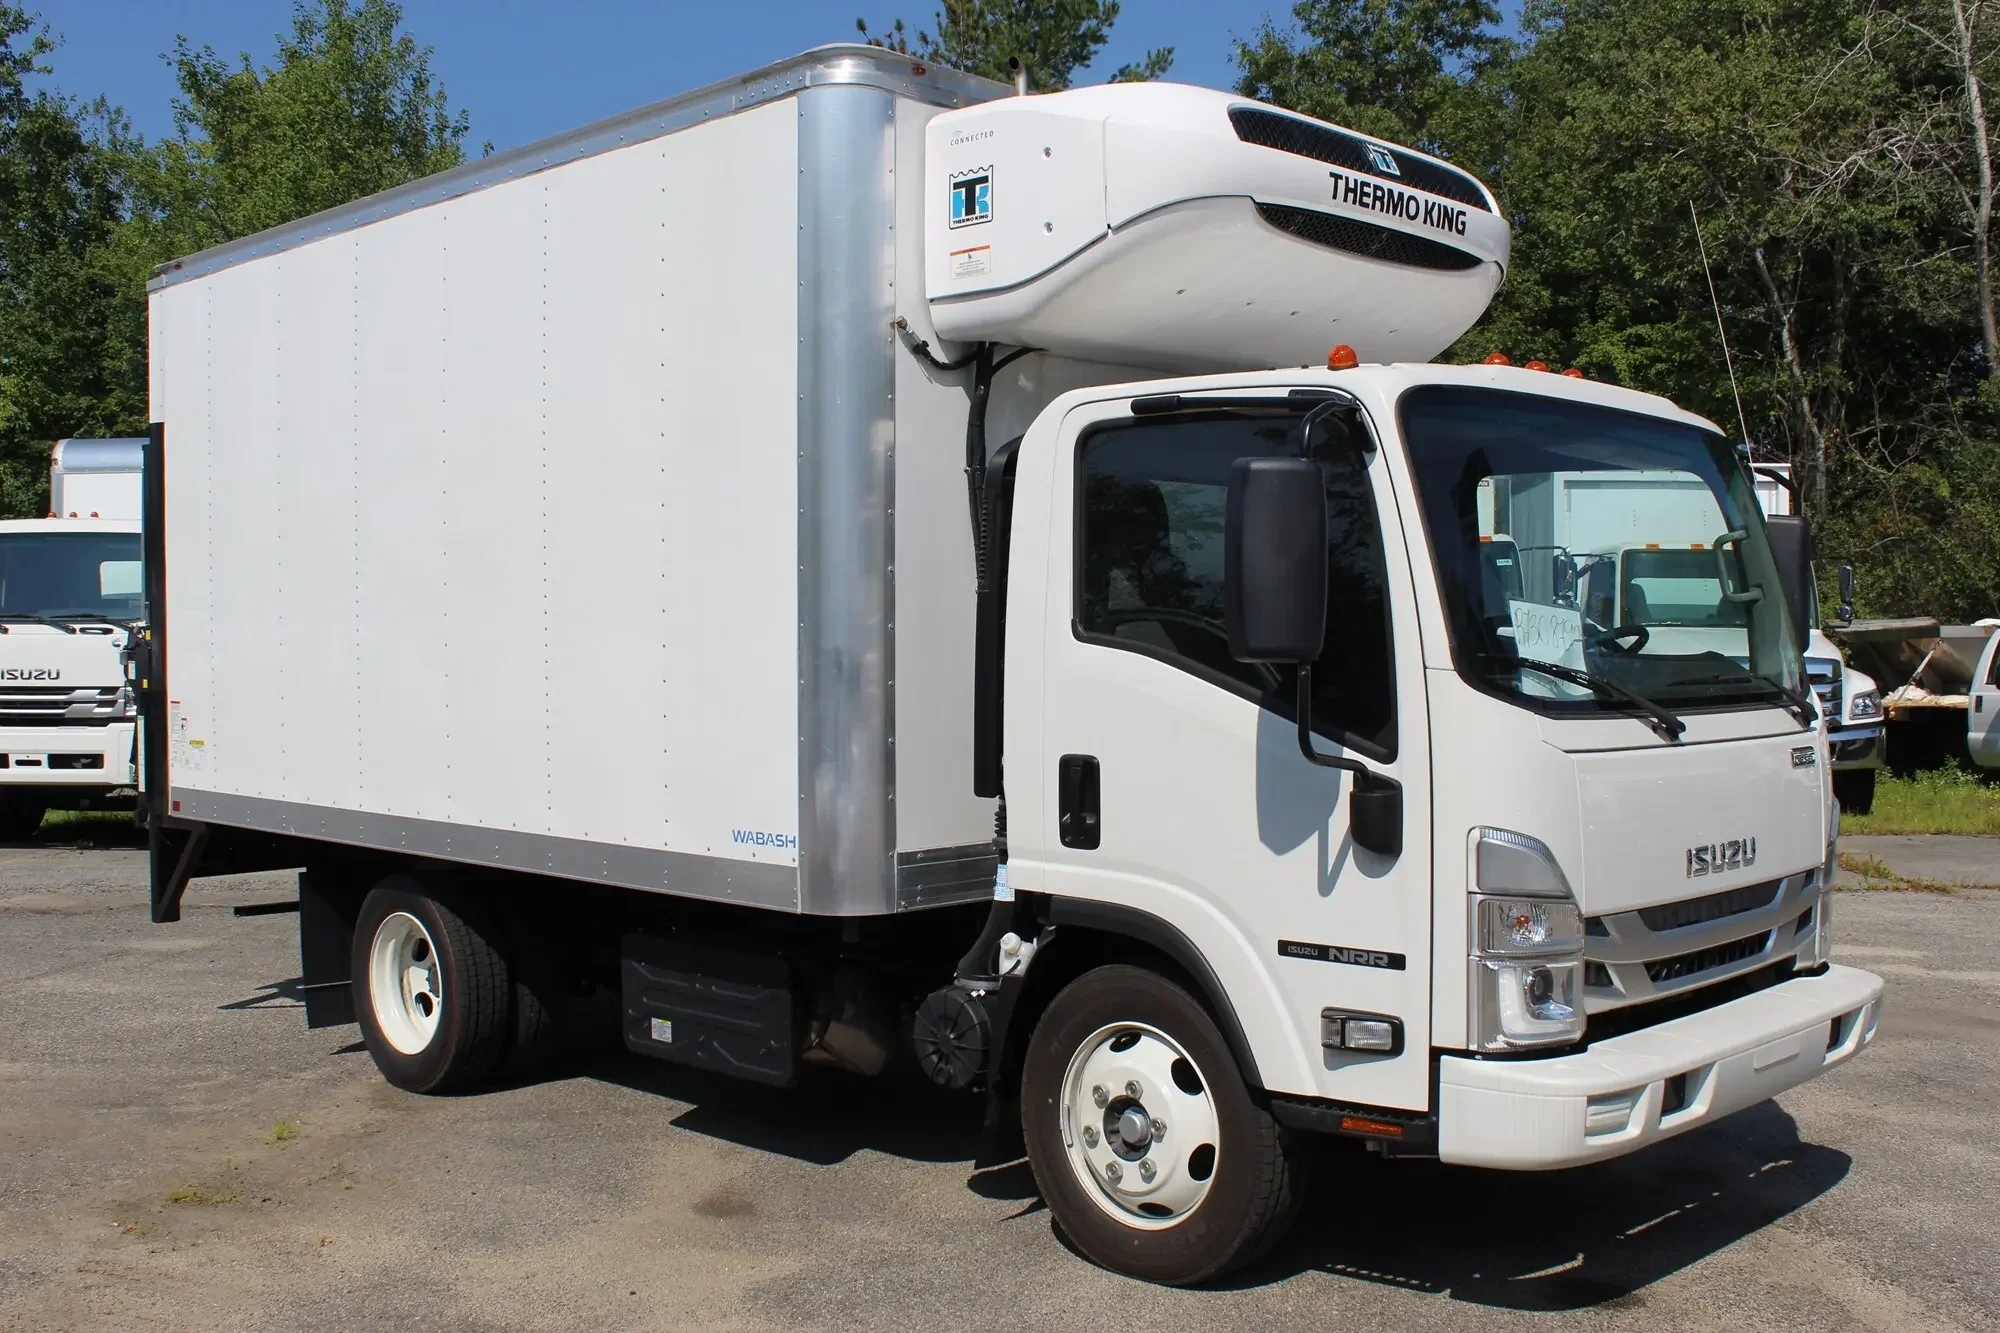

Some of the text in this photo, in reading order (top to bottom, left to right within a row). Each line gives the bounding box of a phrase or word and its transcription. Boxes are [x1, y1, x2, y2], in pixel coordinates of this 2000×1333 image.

[950, 130, 994, 146] CONNECTED
[1329, 171, 1467, 236] THERMO KING
[953, 213, 989, 225] THERMO KING
[1, 669, 60, 680] ISUZU
[732, 828, 796, 848] WABASH
[1685, 836, 1756, 878] ISUZU
[1287, 945, 1389, 968] ISUZU NRR
